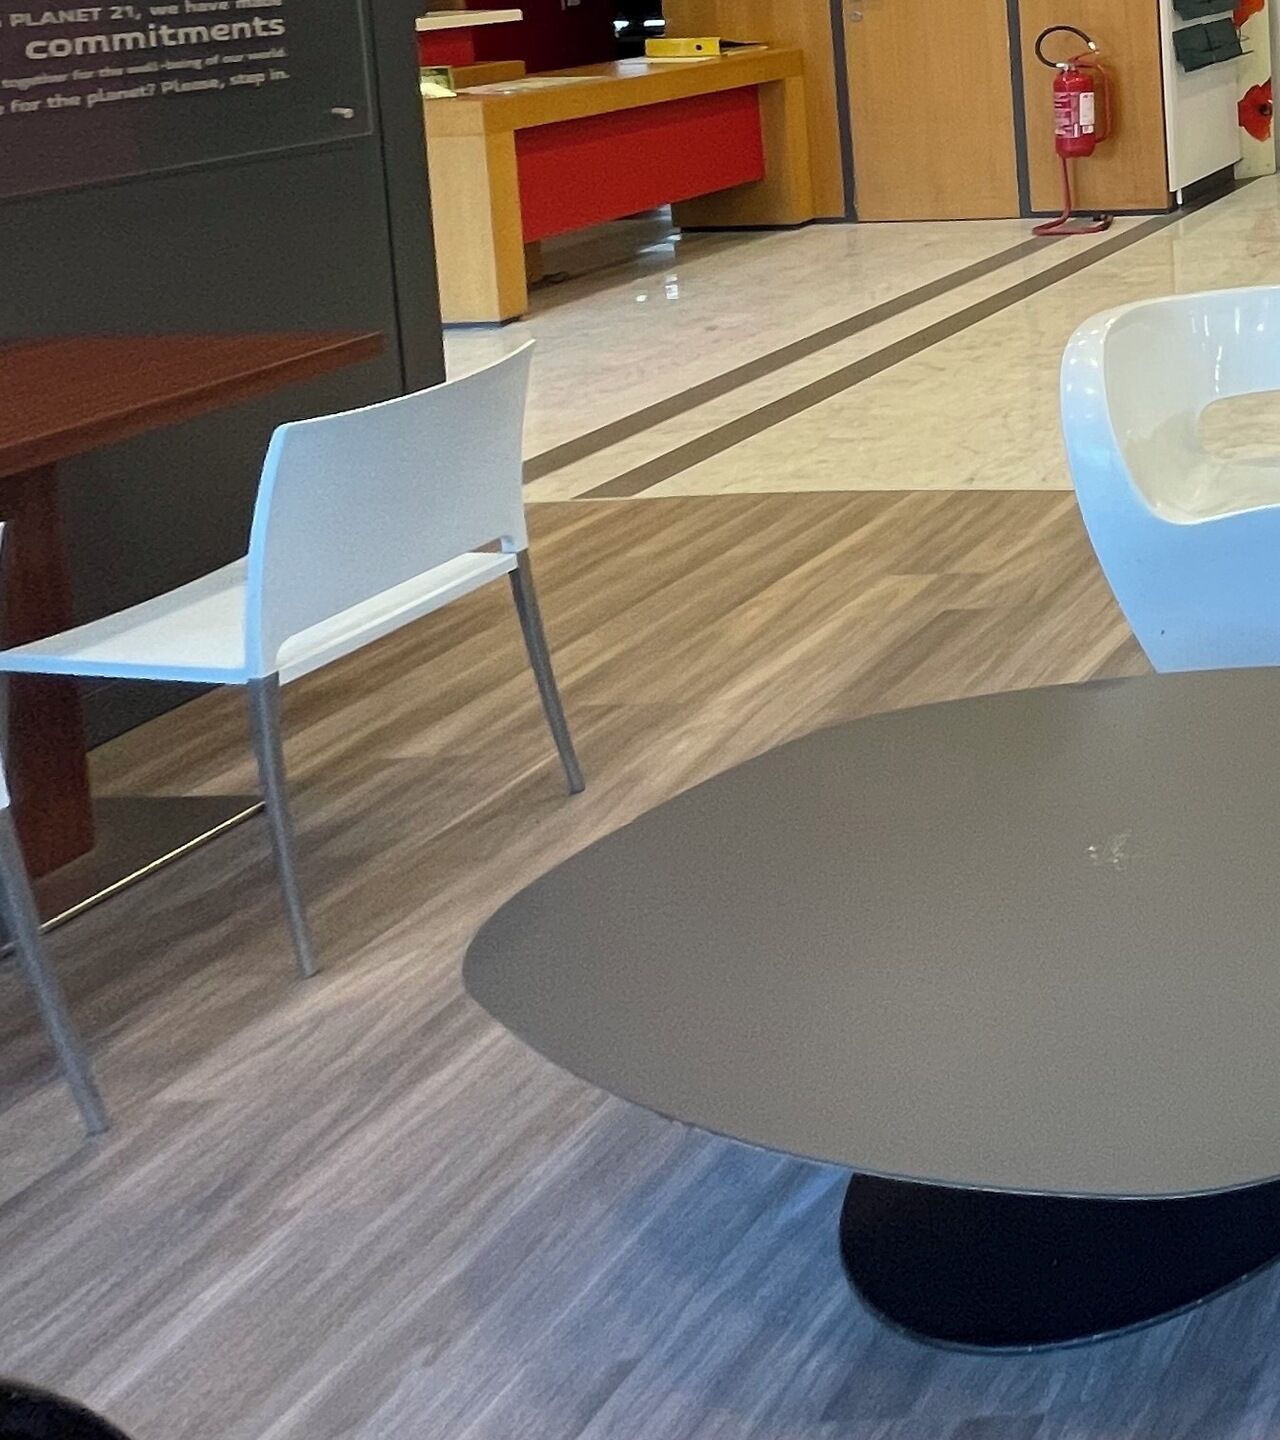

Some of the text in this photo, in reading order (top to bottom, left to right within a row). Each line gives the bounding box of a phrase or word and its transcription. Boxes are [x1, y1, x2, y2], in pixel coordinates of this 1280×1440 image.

[10, 7, 102, 28] PLANET
[109, 5, 142, 21] 21,
[150, 5, 179, 17] we
[185, 0, 230, 14] have
[25, 16, 286, 60] commitments
[46, 93, 82, 109] the
[87, 83, 156, 108] planet?
